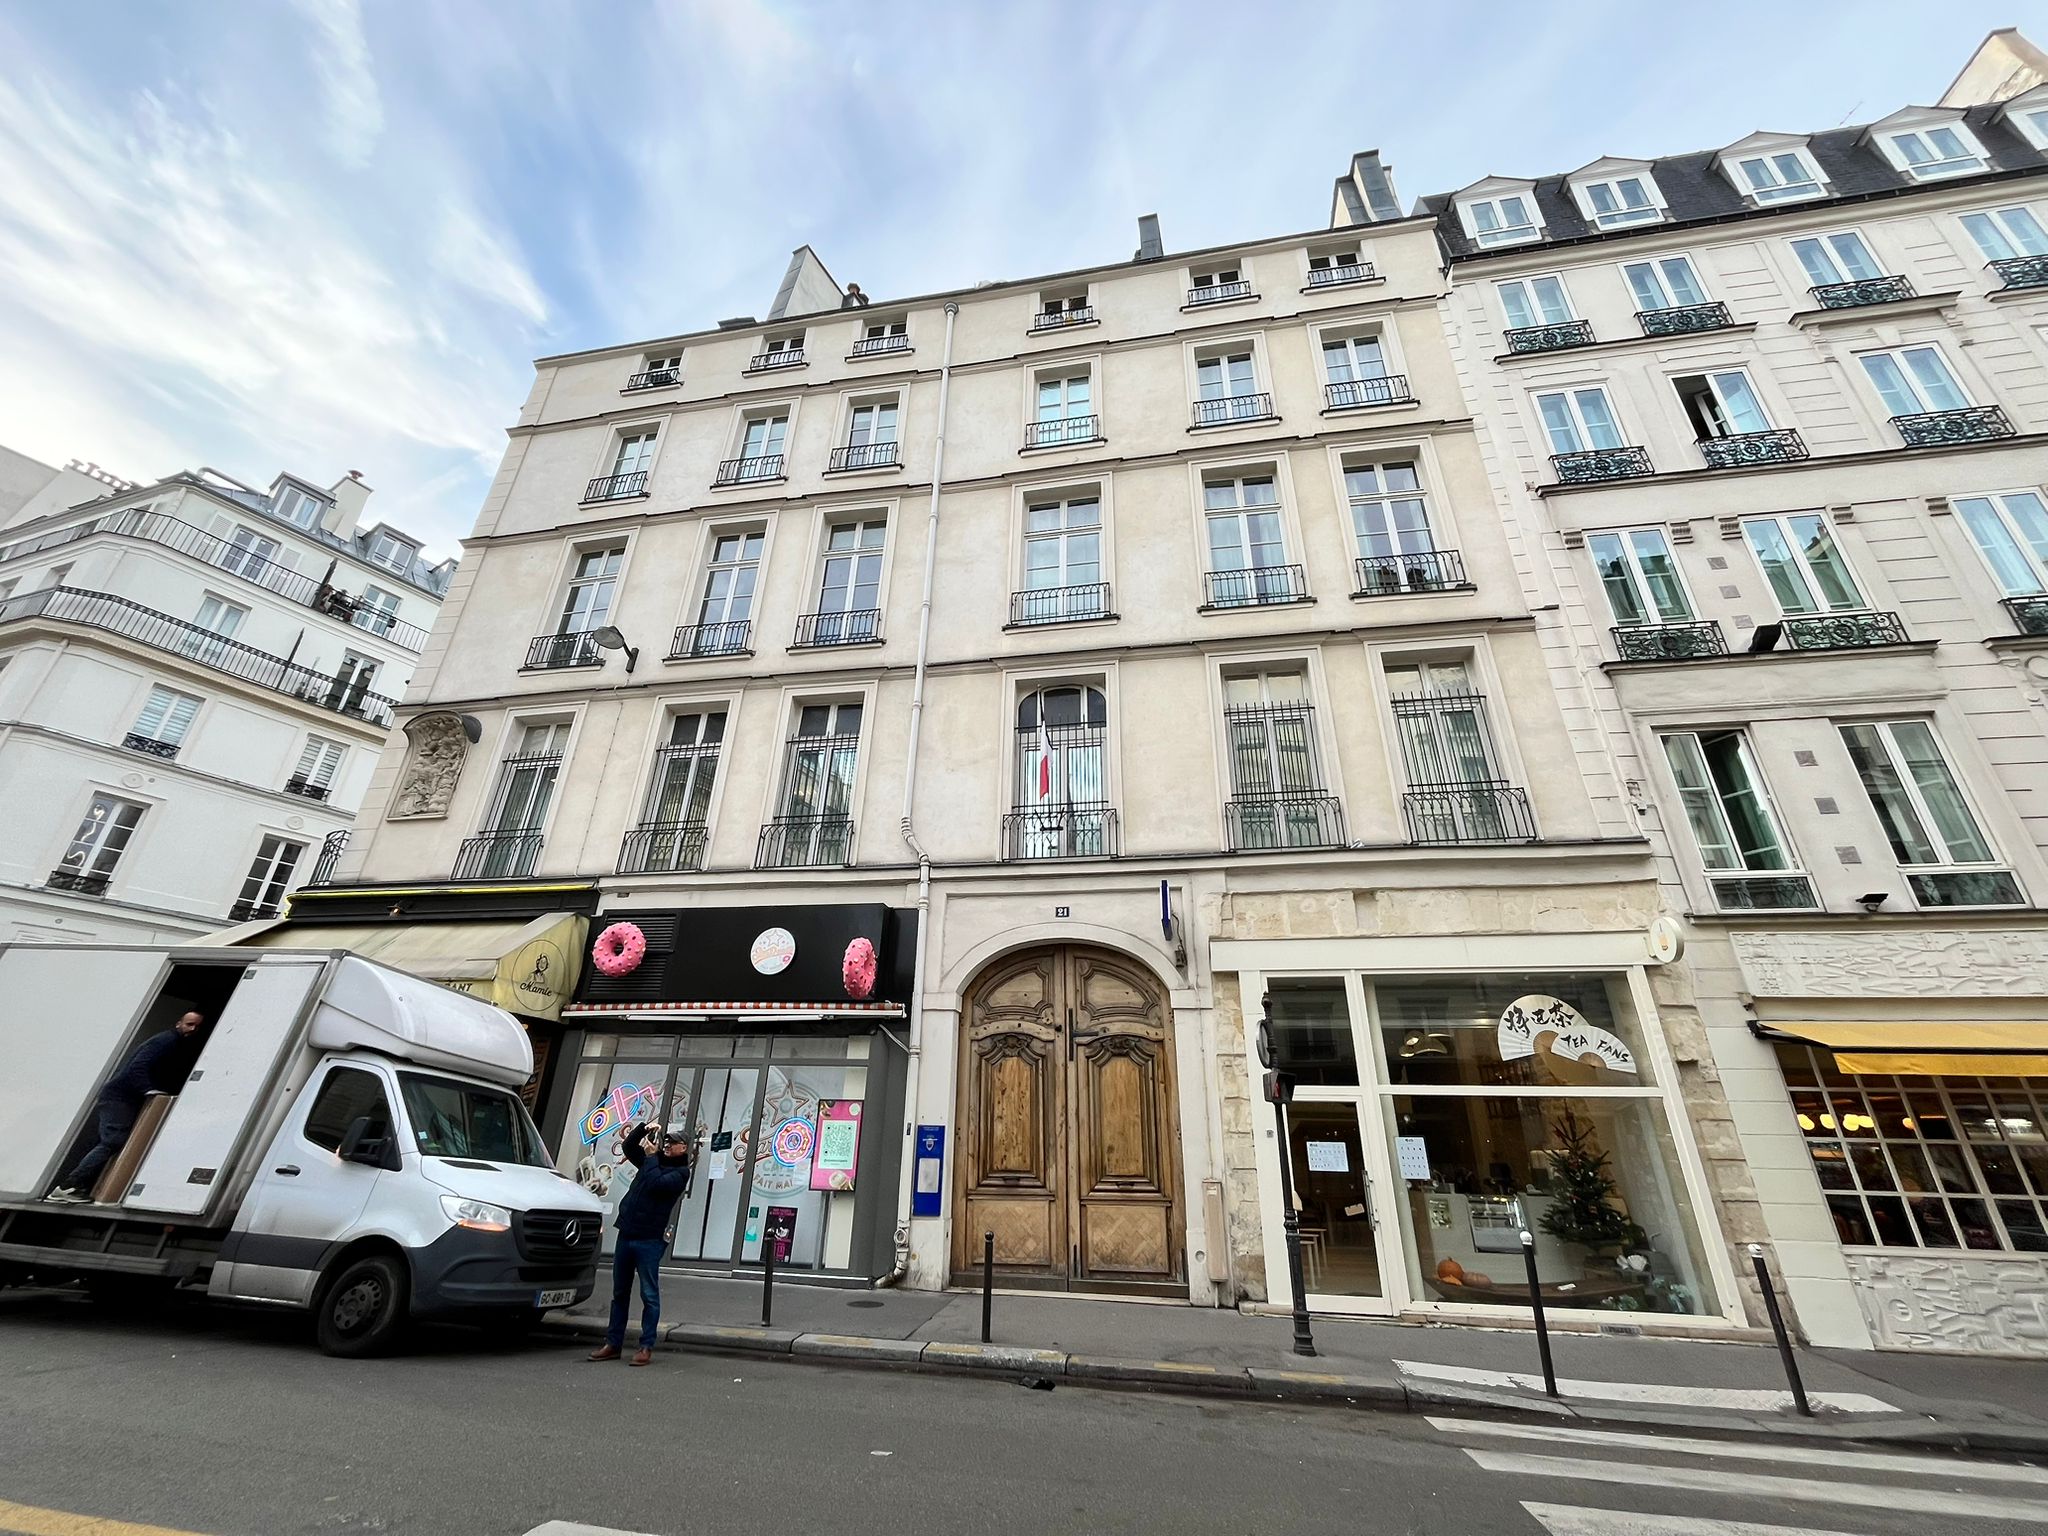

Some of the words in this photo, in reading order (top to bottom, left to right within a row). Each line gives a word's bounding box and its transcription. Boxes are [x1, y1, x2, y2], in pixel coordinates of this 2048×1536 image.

[1057, 907, 1068, 917] 21
[1560, 1034, 1588, 1051] TEA
[1596, 1039, 1630, 1063] FANS
